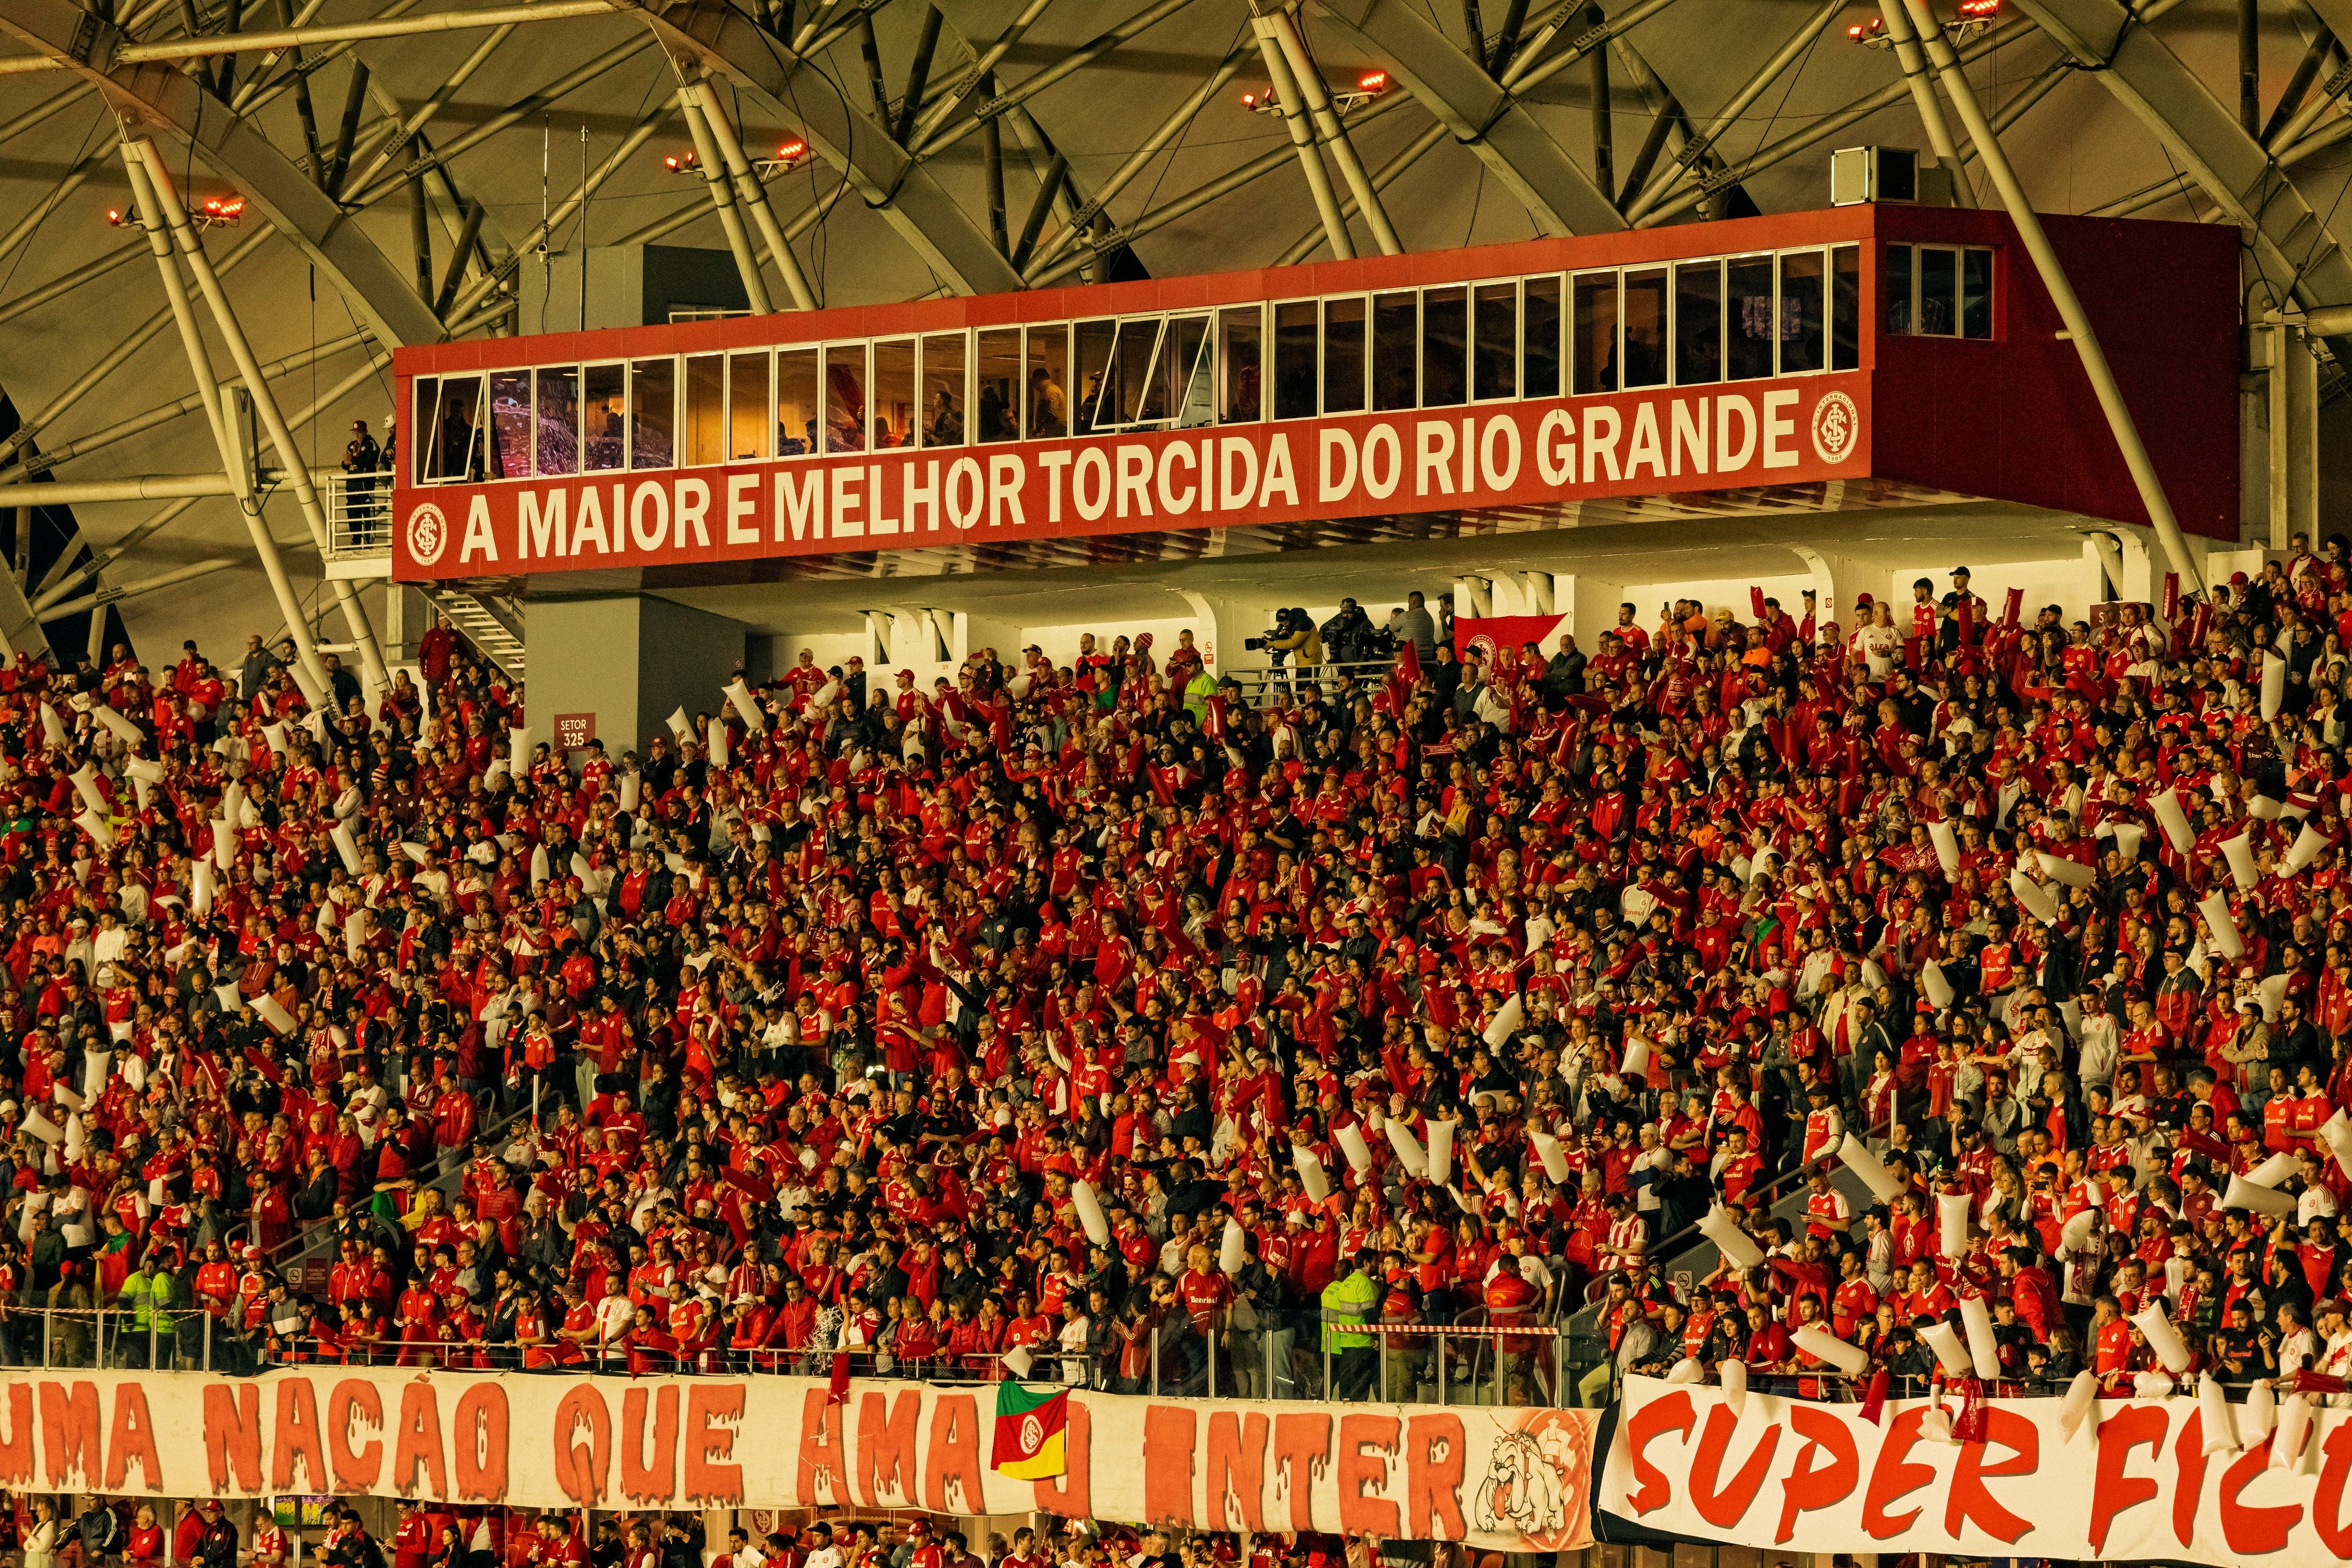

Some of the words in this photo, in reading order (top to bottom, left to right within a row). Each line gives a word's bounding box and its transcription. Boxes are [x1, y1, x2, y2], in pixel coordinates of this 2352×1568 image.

[460, 495, 498, 563] A
[518, 478, 711, 559] MAIOR
[727, 474, 759, 544] E
[774, 454, 1025, 542] MELHOR
[1039, 433, 1299, 523] TORCIDA
[1319, 423, 1401, 503] DO
[1416, 414, 1521, 496] RIO
[1536, 389, 1799, 486] GRANDE
[561, 719, 586, 730] SETOR
[564, 732, 584, 747] 325
[1014, 1333, 1020, 1341] 10
[553, 1383, 746, 1507] QUE
[796, 1388, 987, 1516] AMA
[1142, 1403, 1468, 1542] INTER
[1625, 1389, 2040, 1546] SUPER
